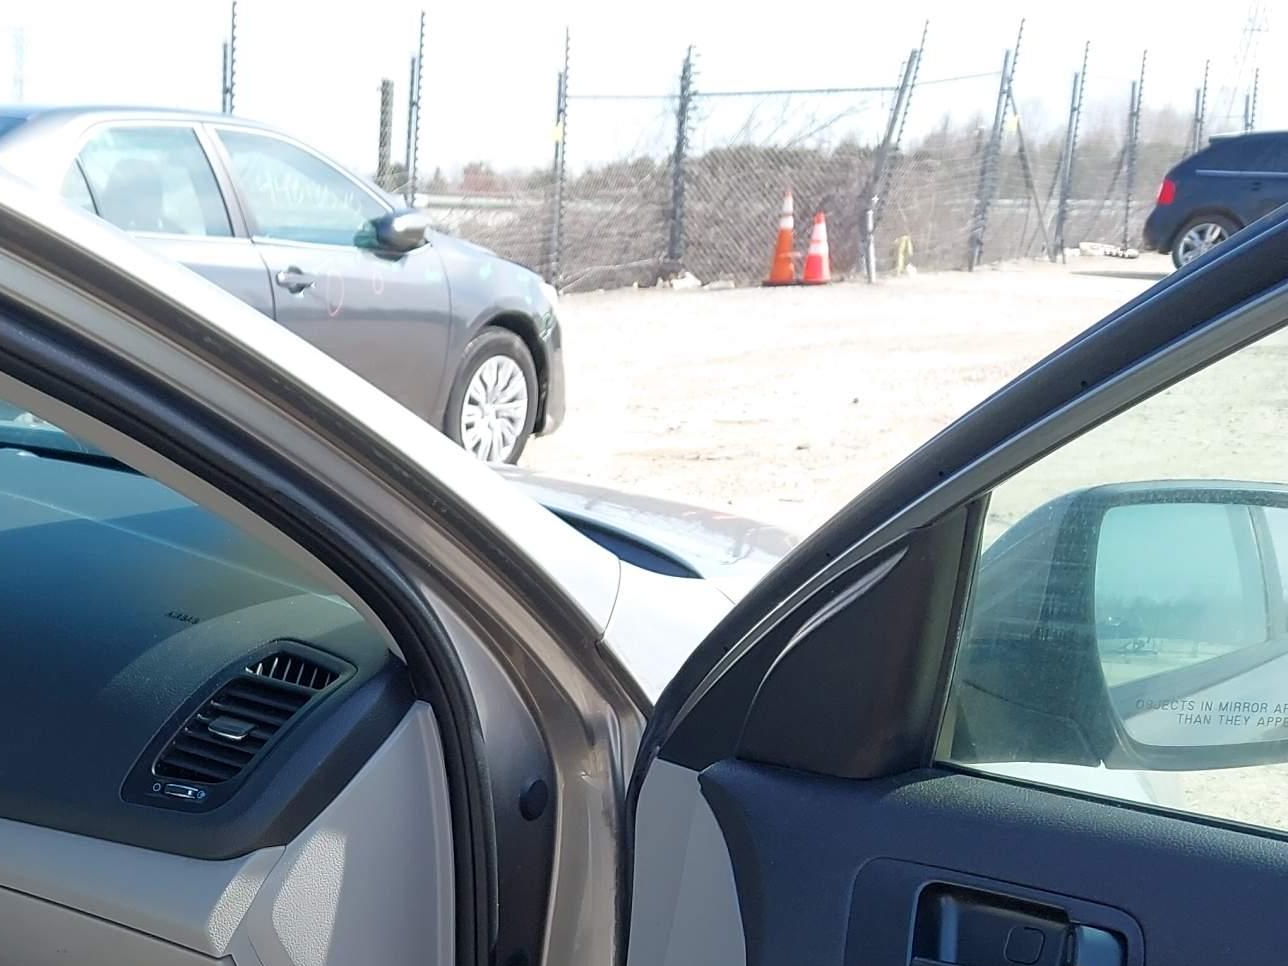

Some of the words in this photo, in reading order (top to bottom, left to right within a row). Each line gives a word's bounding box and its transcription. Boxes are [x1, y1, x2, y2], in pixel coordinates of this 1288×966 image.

[1135, 699, 1195, 711] OBJECTS
[1200, 701, 1213, 712] IN
[1218, 702, 1268, 713] MIRROR
[1177, 713, 1212, 725] THAN
[1219, 714, 1251, 726] THEY
